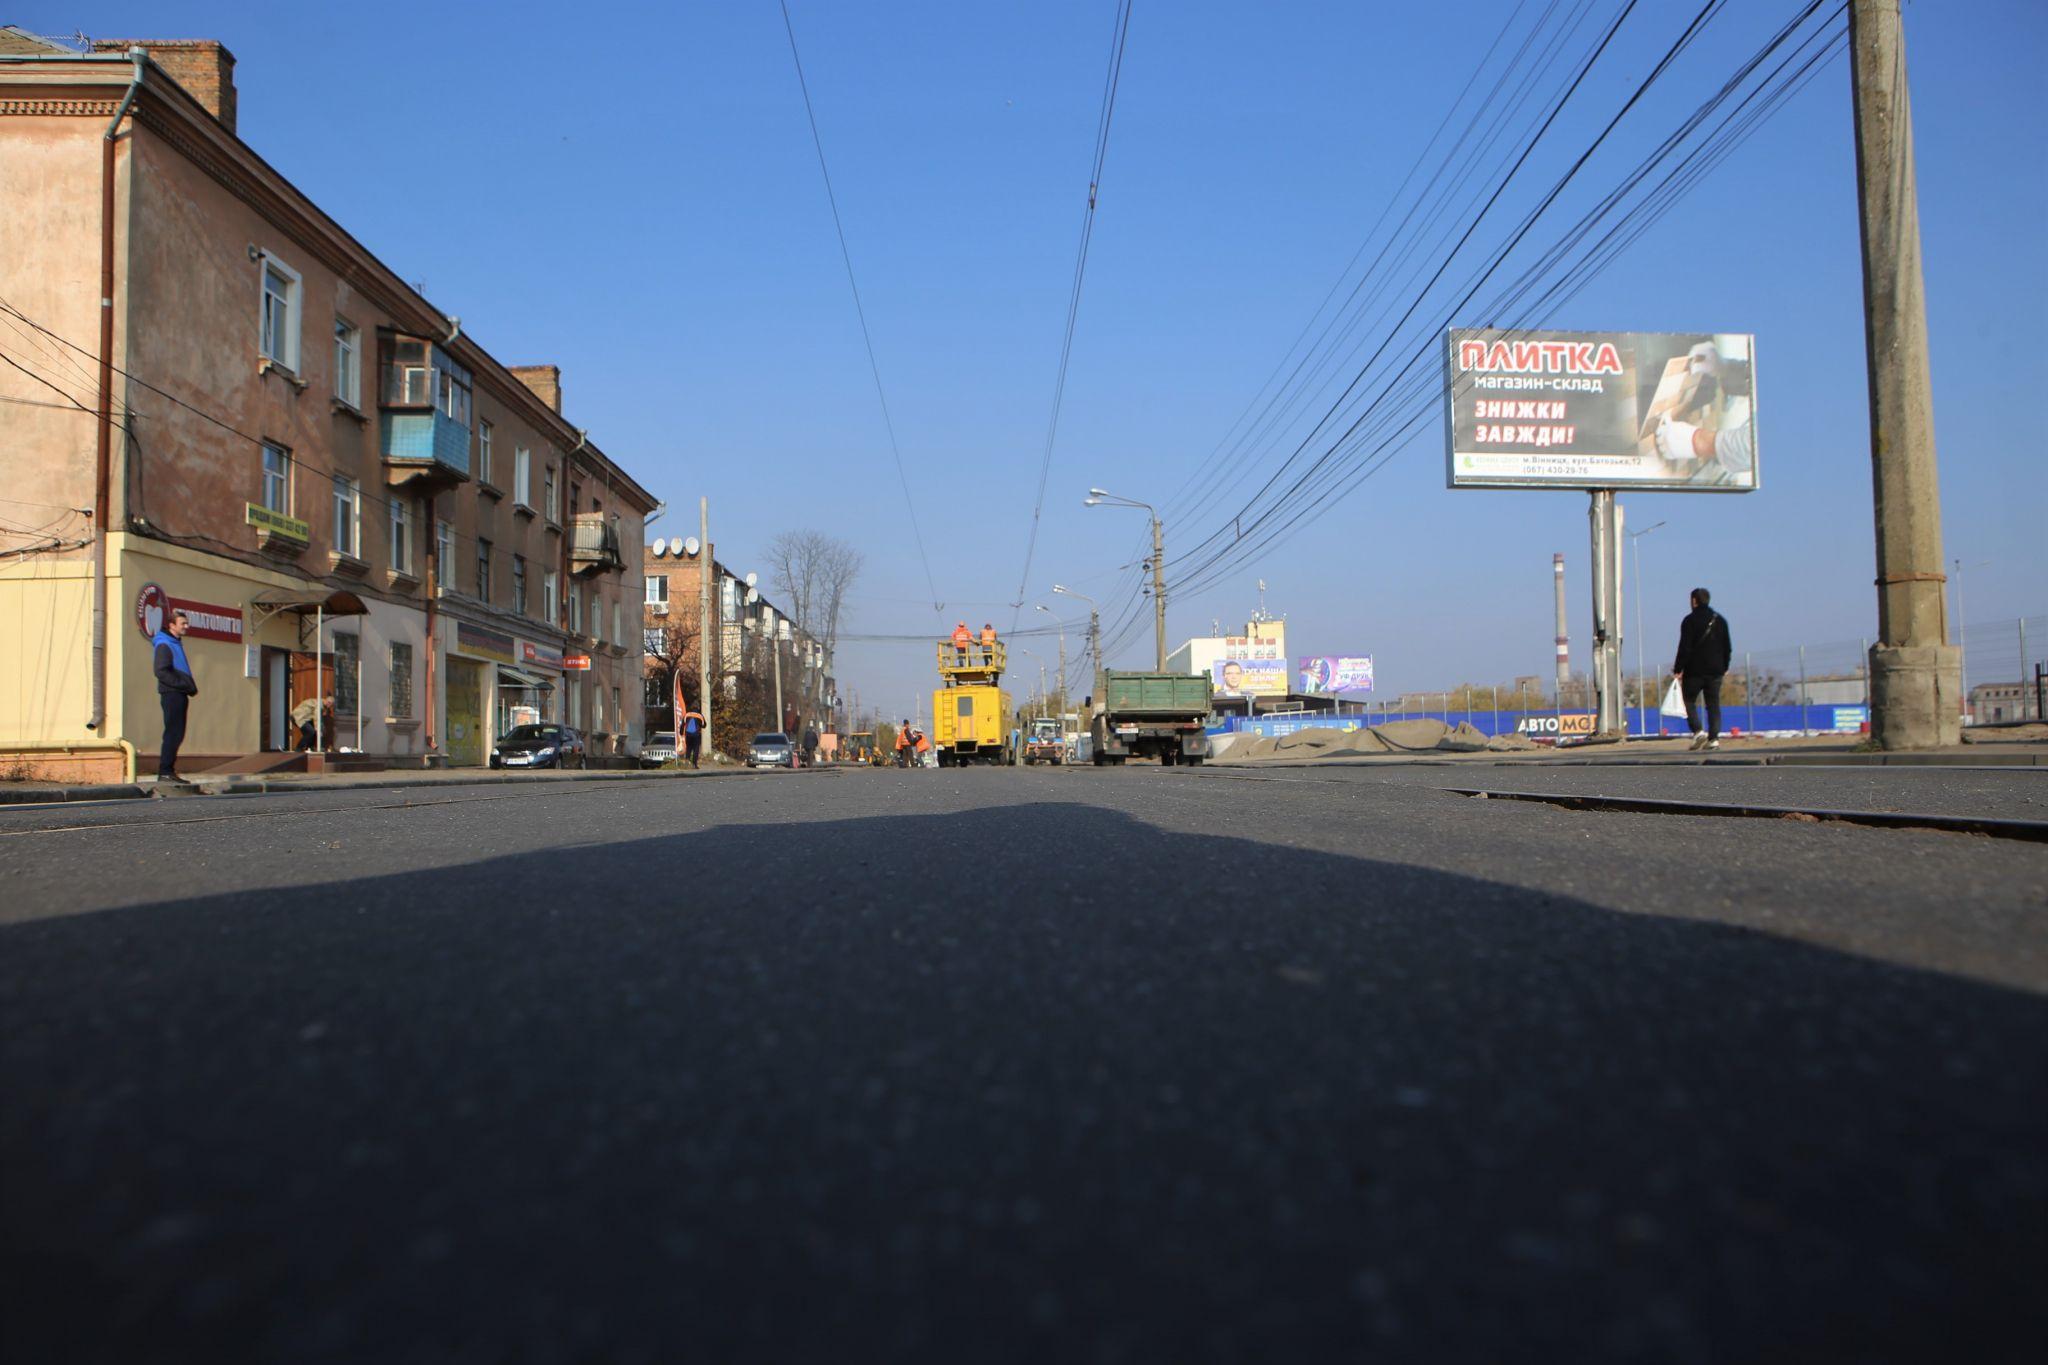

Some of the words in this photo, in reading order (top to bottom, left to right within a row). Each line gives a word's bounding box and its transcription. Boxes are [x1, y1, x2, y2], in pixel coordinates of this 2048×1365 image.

[1460, 340, 1622, 374] ПЛИТКА
[1474, 376, 1603, 393] магазин-склад
[1474, 400, 1566, 420] ЗНИЖКИ
[1474, 424, 1574, 446] ЗАВЖДИ!
[1518, 718, 1558, 732] АВТО
